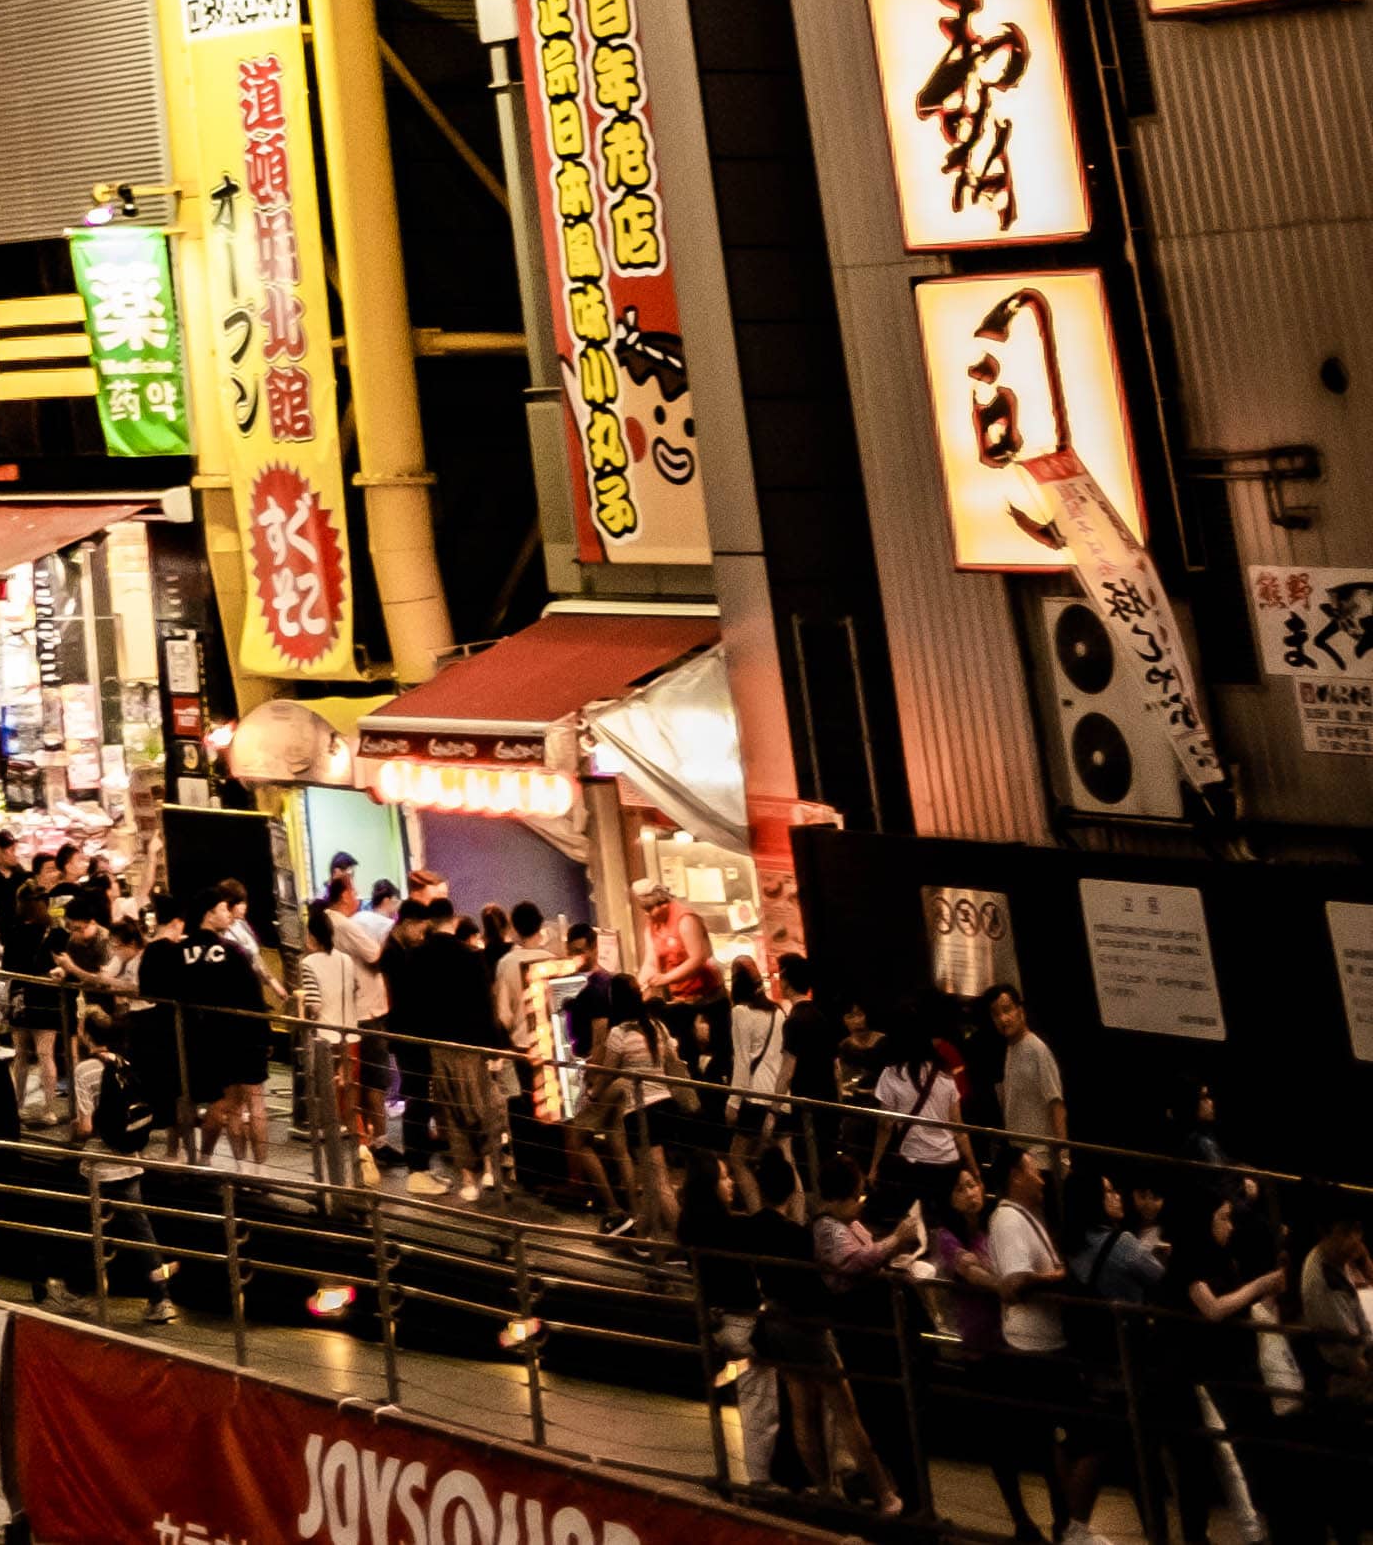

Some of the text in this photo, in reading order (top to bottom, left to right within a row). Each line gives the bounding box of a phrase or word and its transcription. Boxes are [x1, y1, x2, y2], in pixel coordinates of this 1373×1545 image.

[235, 53, 316, 445] 道頓堀北館
[85, 261, 170, 352] 薬
[209, 171, 261, 439] オープン
[257, 491, 318, 566] すぐ
[271, 566, 327, 638] そこ
